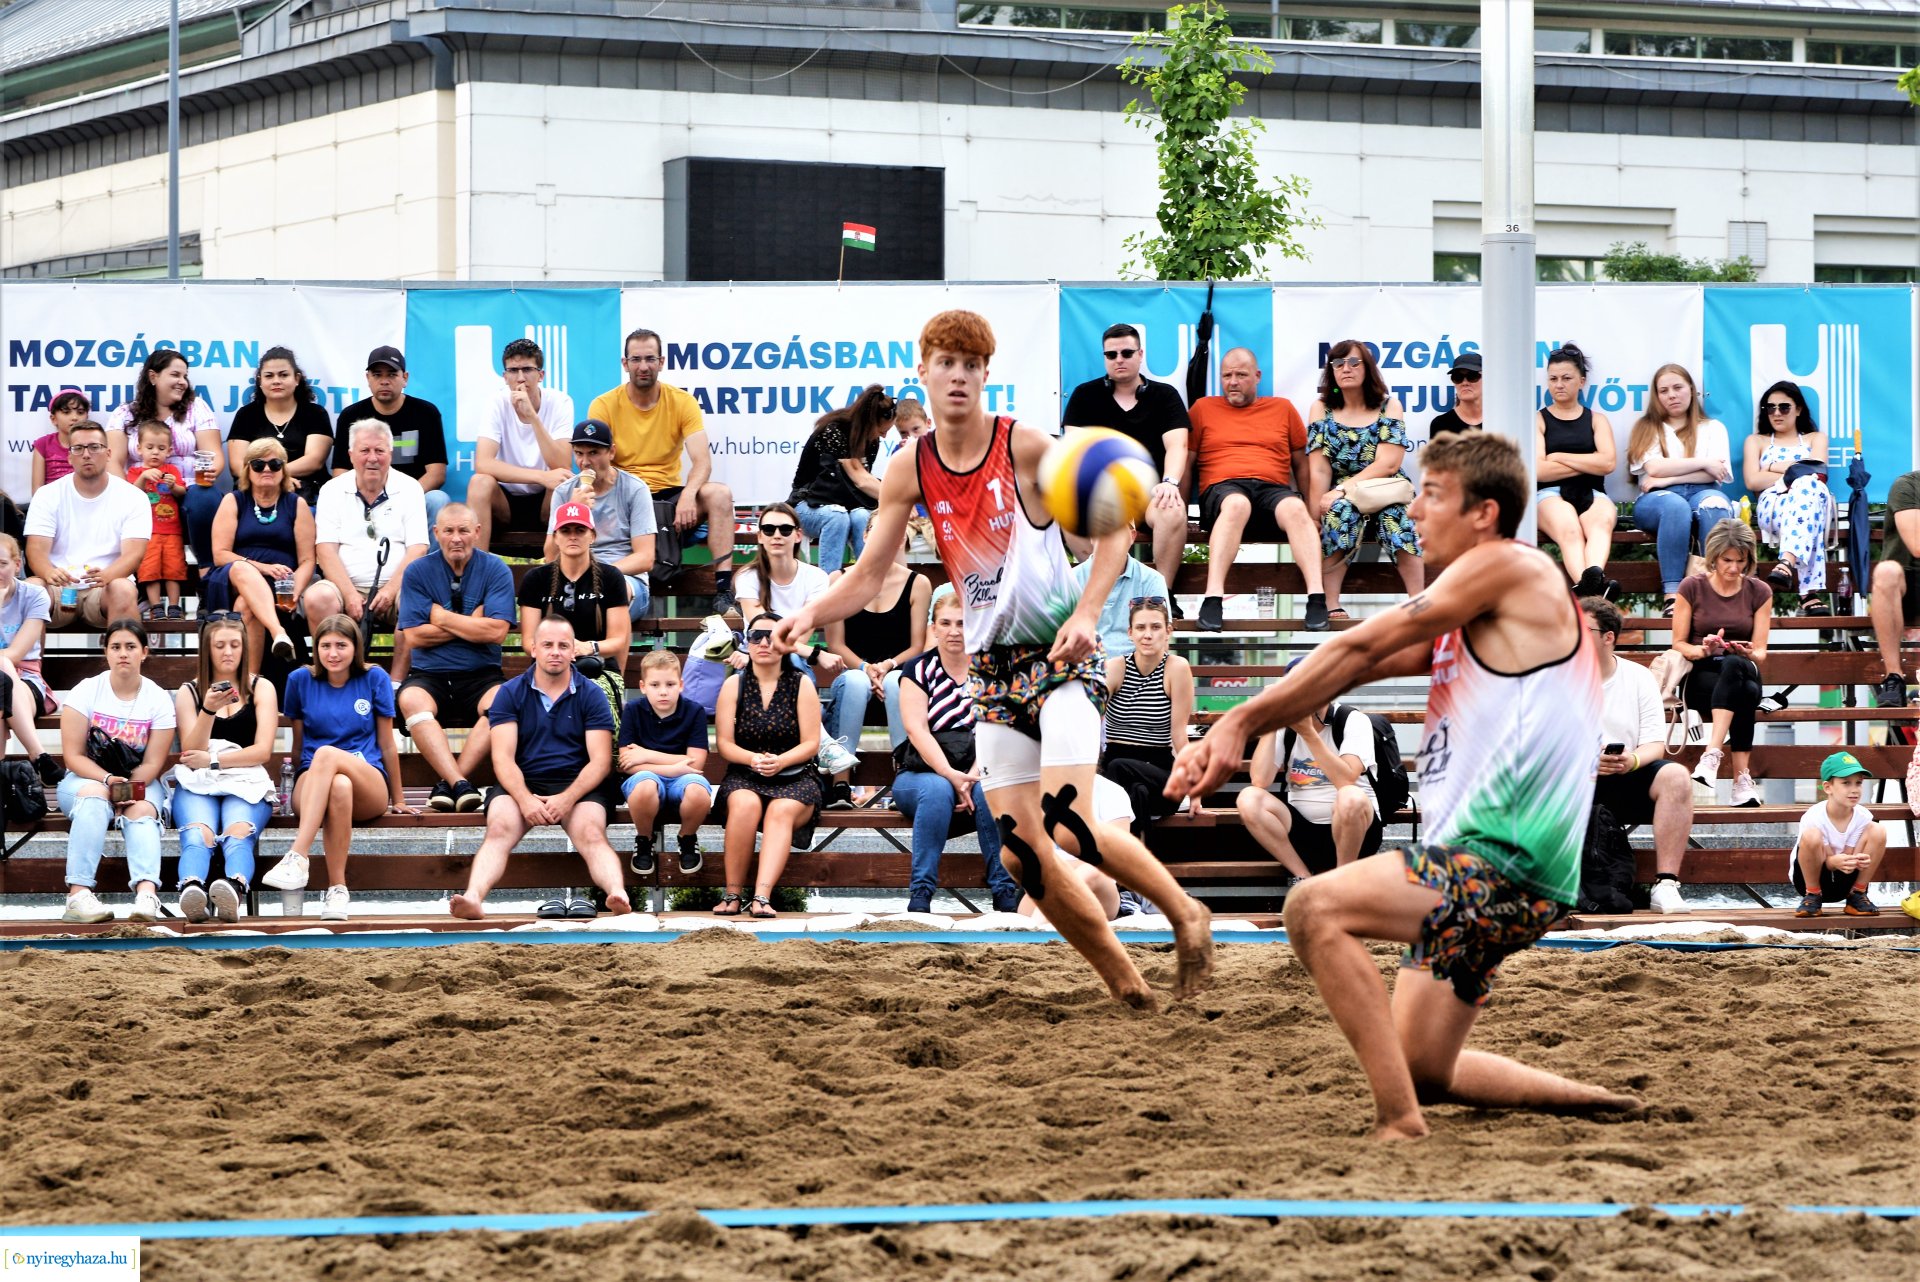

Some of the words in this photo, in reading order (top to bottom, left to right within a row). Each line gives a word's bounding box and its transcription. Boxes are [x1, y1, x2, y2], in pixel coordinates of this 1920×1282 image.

[1505, 224, 1520, 232] 36
[667, 335, 913, 370] MOZGÁSBAN
[679, 386, 835, 414] ARTJUK
[986, 478, 1005, 511] 1
